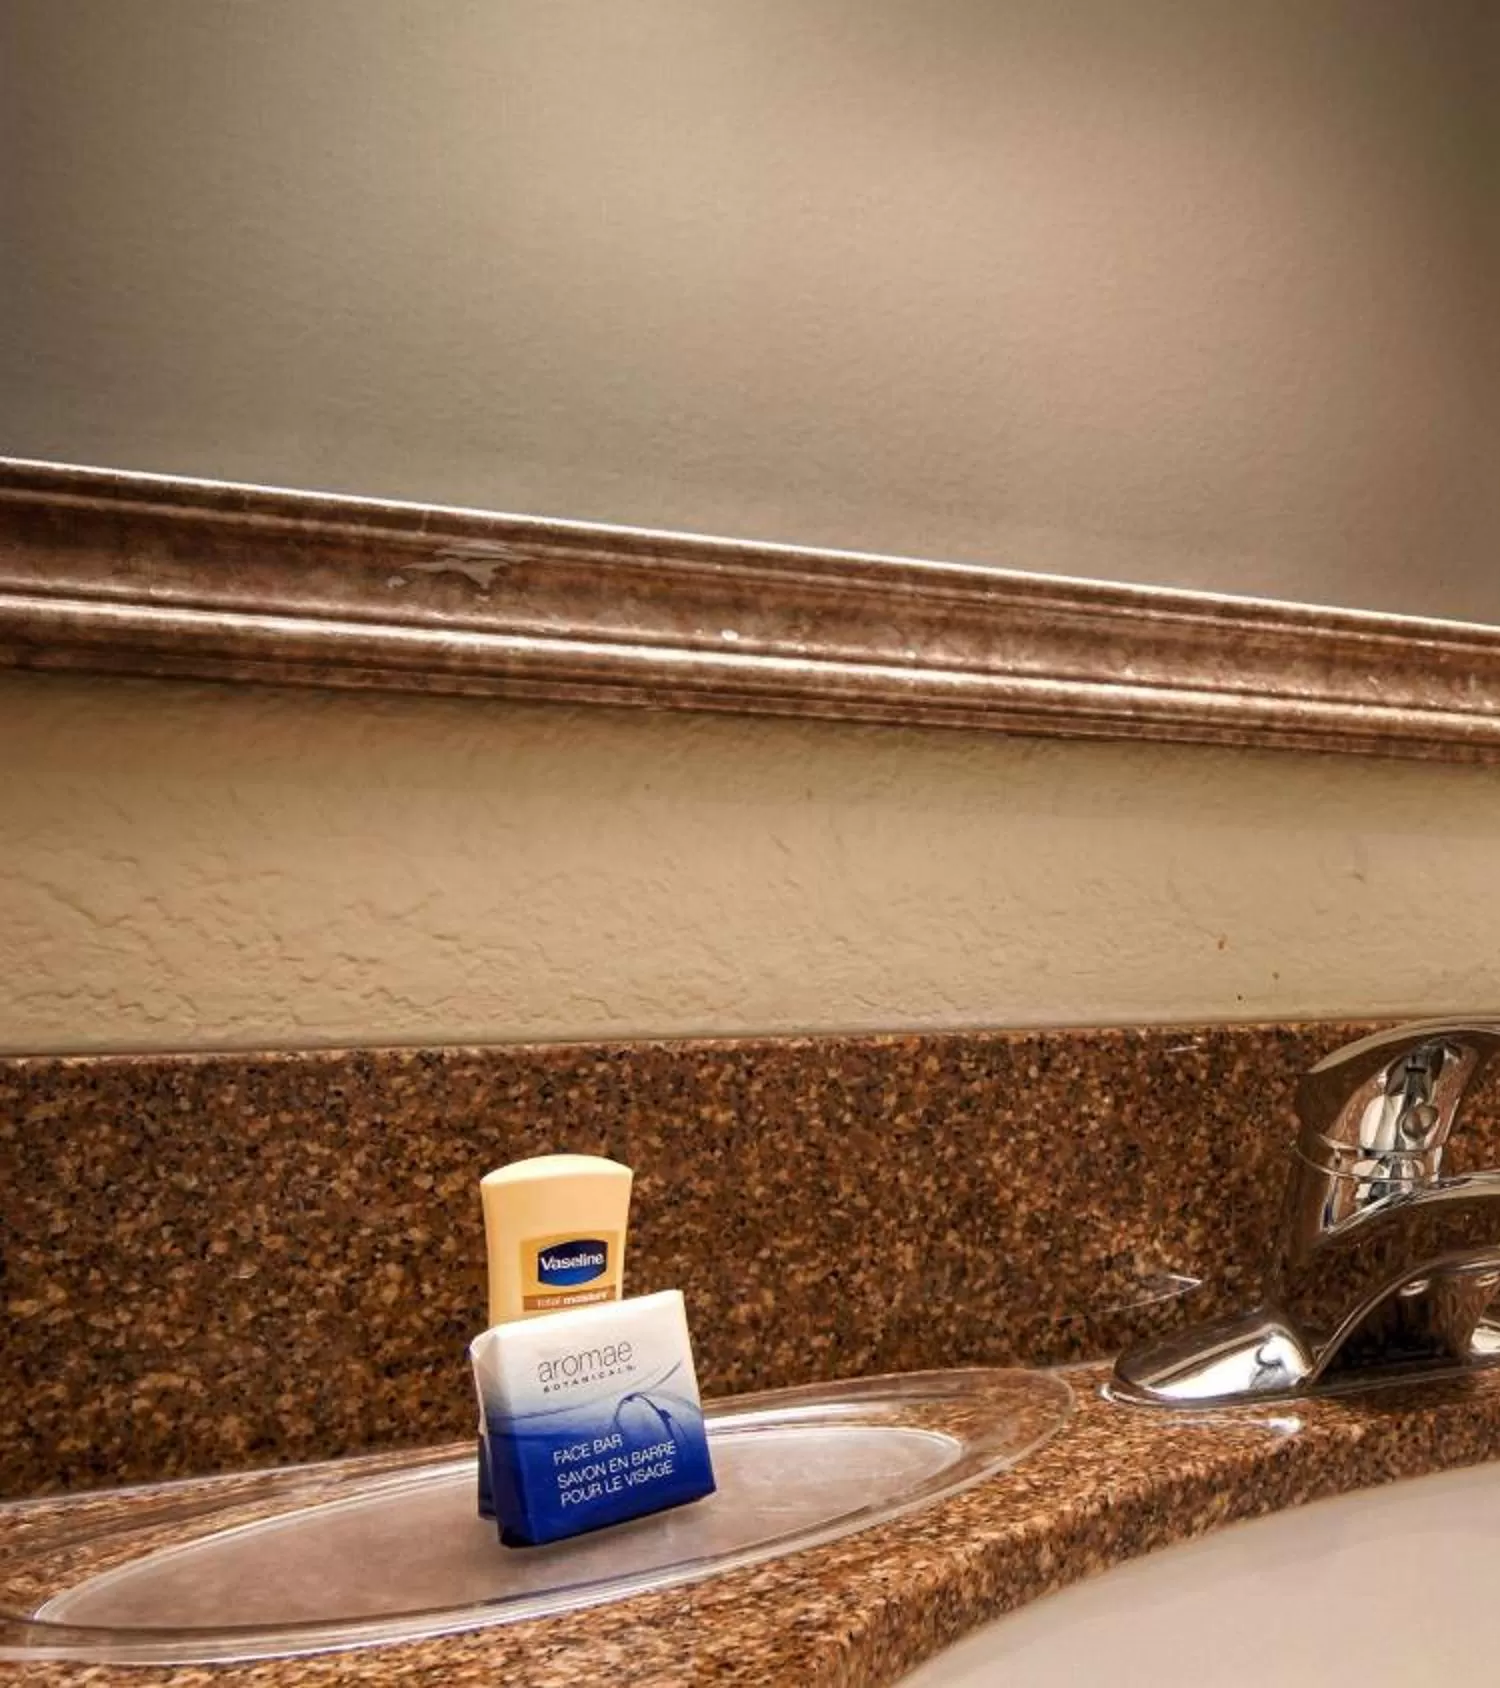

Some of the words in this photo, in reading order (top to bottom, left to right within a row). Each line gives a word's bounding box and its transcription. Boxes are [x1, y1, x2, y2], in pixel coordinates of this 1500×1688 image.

[540, 1253, 605, 1271] Vaseline
[537, 1341, 633, 1382] aromae
[553, 1444, 591, 1466] FACE
[593, 1433, 623, 1455] BAR
[557, 1462, 607, 1489] SAVON
[609, 1456, 629, 1473] EN
[631, 1440, 677, 1467] BARRE
[560, 1482, 603, 1508] POUR
[604, 1475, 624, 1493] LE
[623, 1460, 674, 1487] VISAGE
